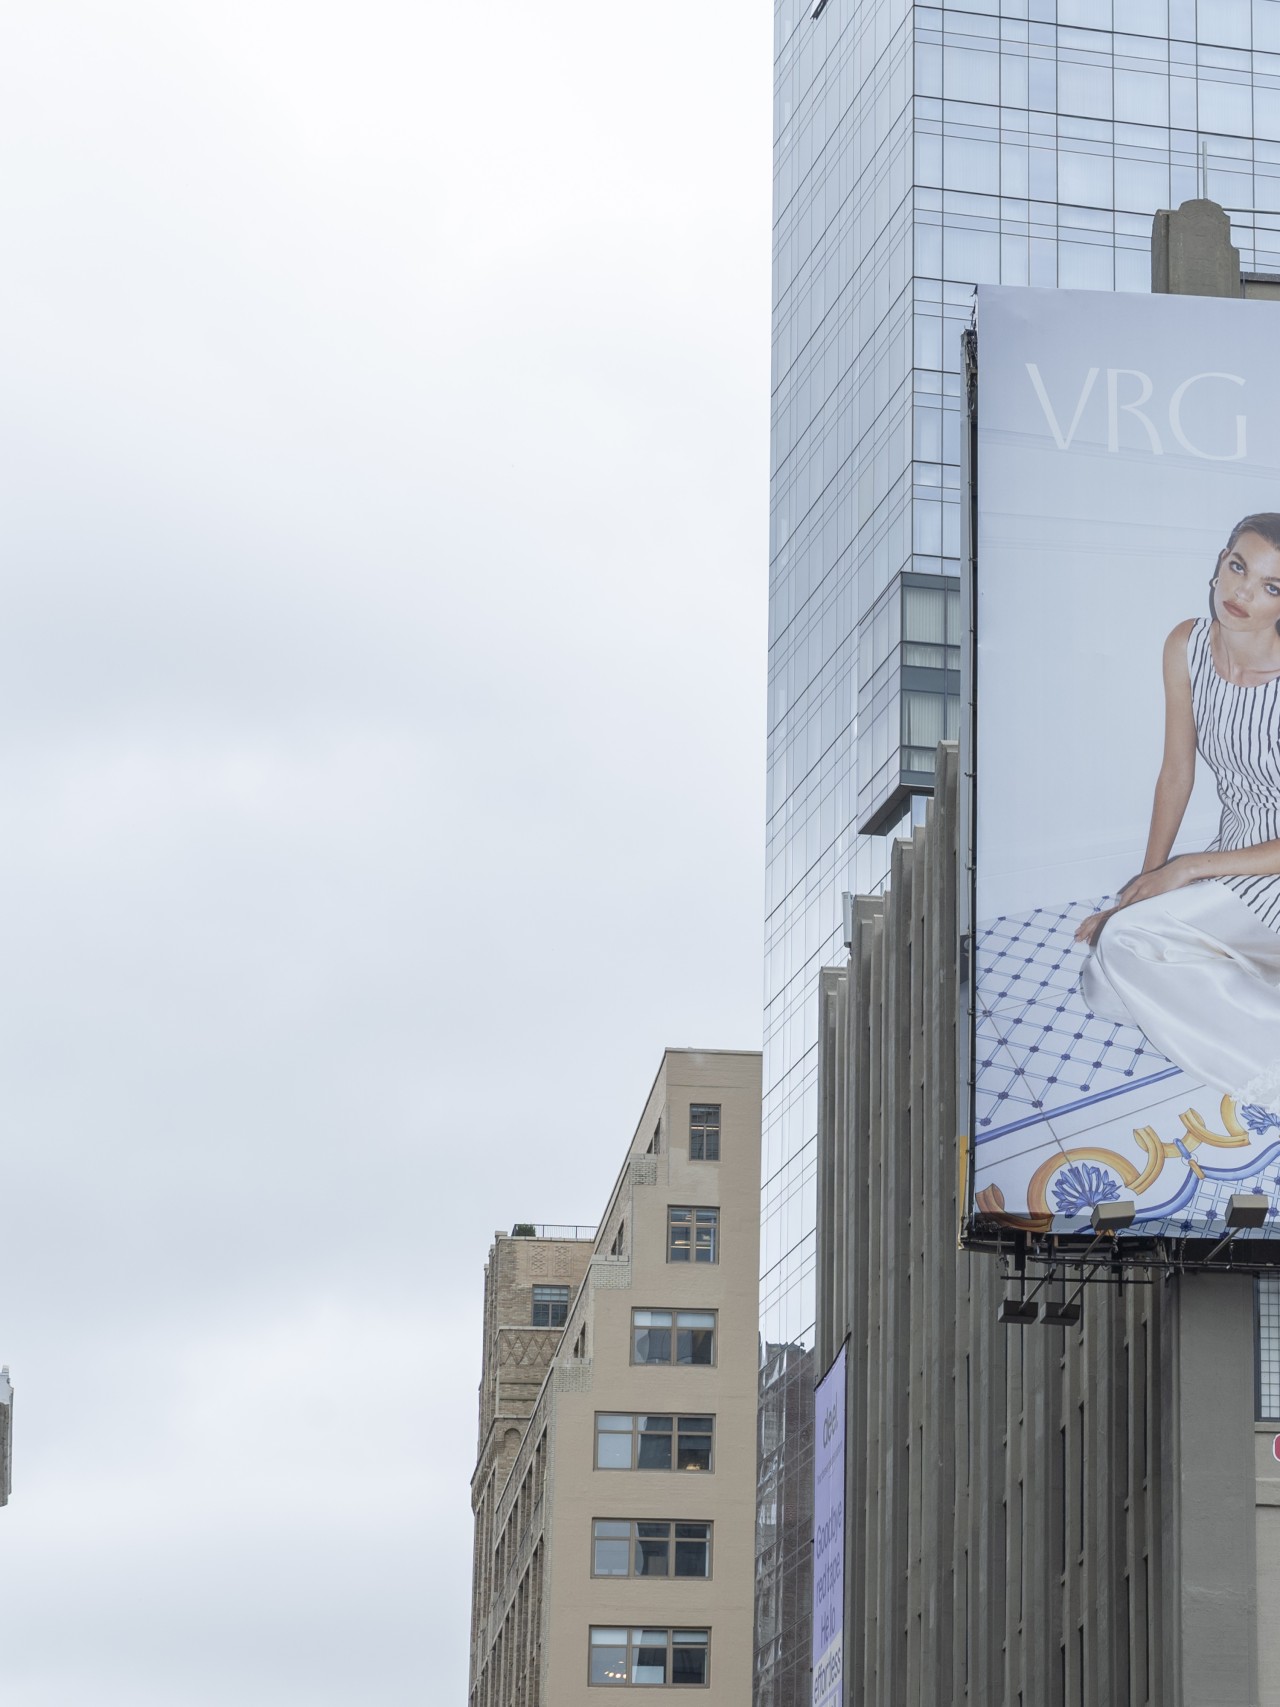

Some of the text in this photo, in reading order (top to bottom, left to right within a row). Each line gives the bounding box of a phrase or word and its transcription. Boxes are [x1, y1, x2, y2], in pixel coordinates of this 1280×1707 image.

[1025, 362, 1247, 461] VRG
[816, 1500, 843, 1560] Goodbye
[820, 1603, 836, 1649] Hello
[814, 1646, 842, 1705] effortless
